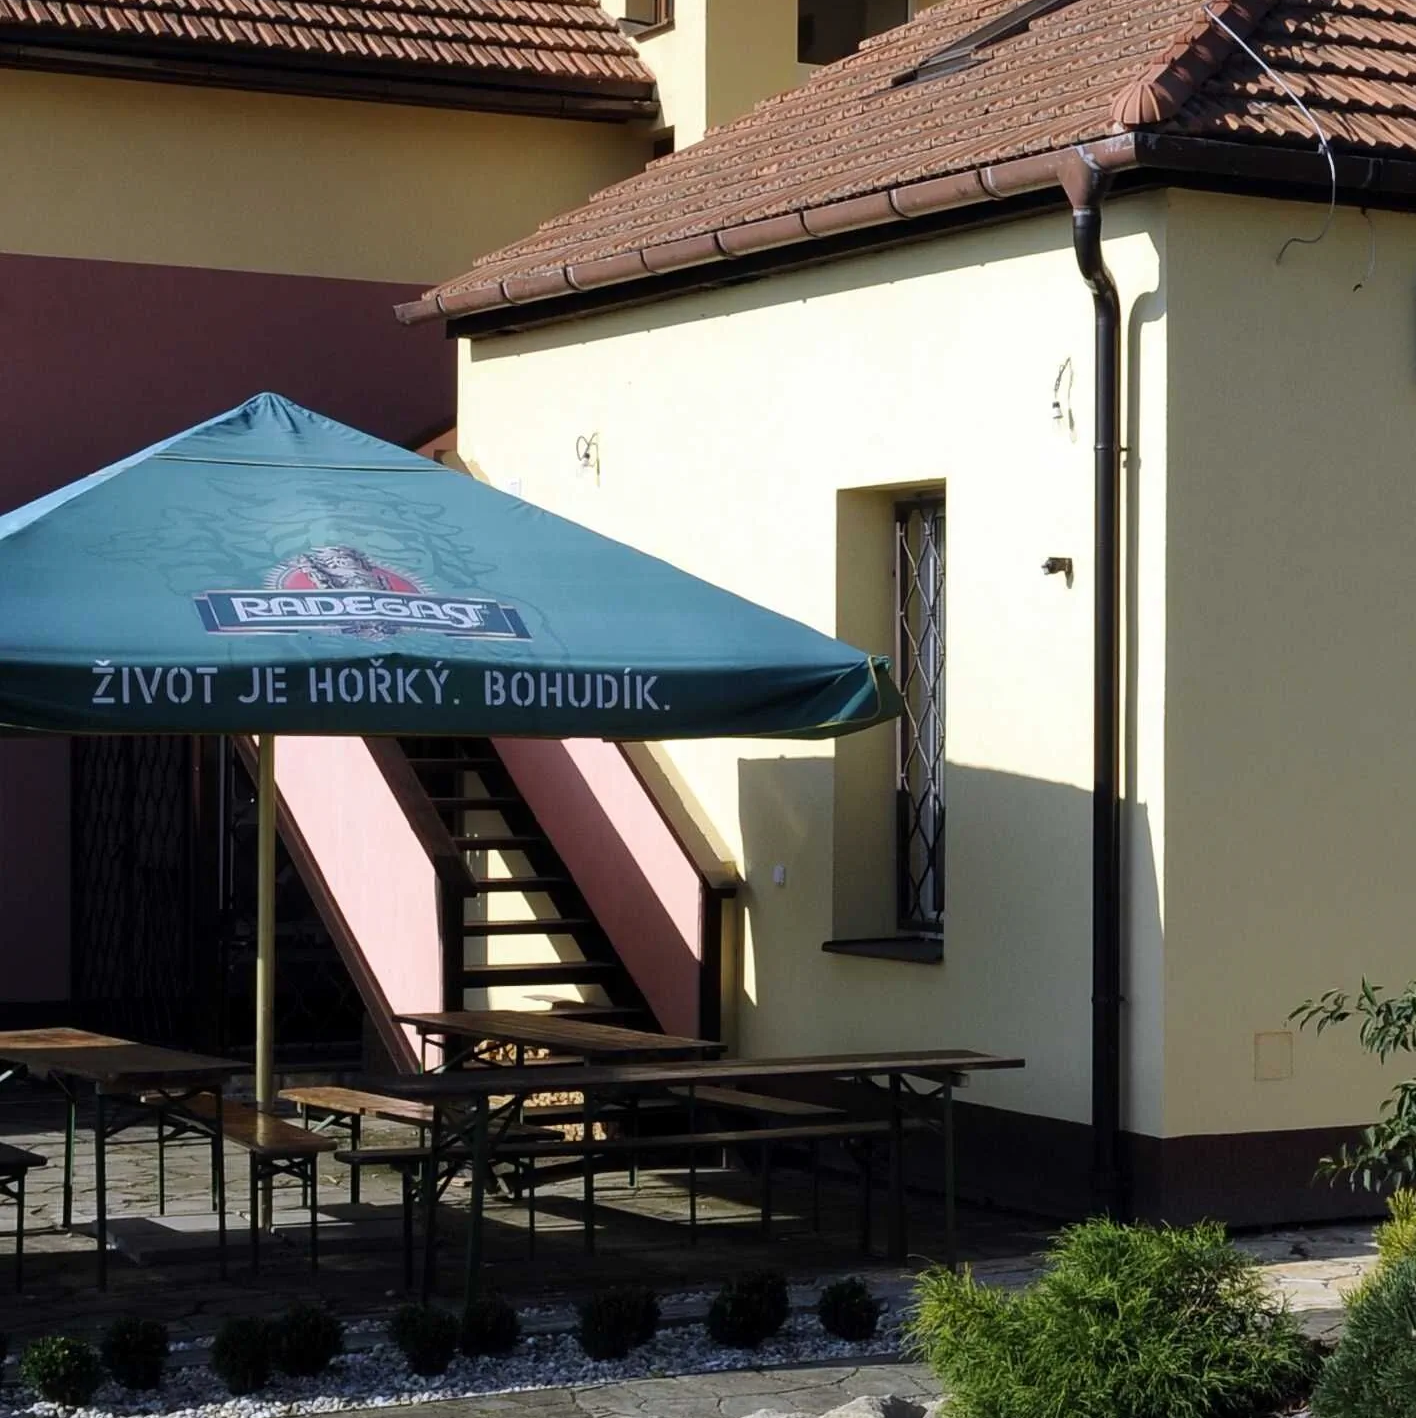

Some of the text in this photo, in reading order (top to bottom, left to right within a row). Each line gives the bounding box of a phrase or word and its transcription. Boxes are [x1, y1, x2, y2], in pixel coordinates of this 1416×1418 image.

[230, 596, 485, 628] RADEGAST
[92, 658, 670, 710] ŽIVOT JE HOŘKÝ. BOHUDÍK.
